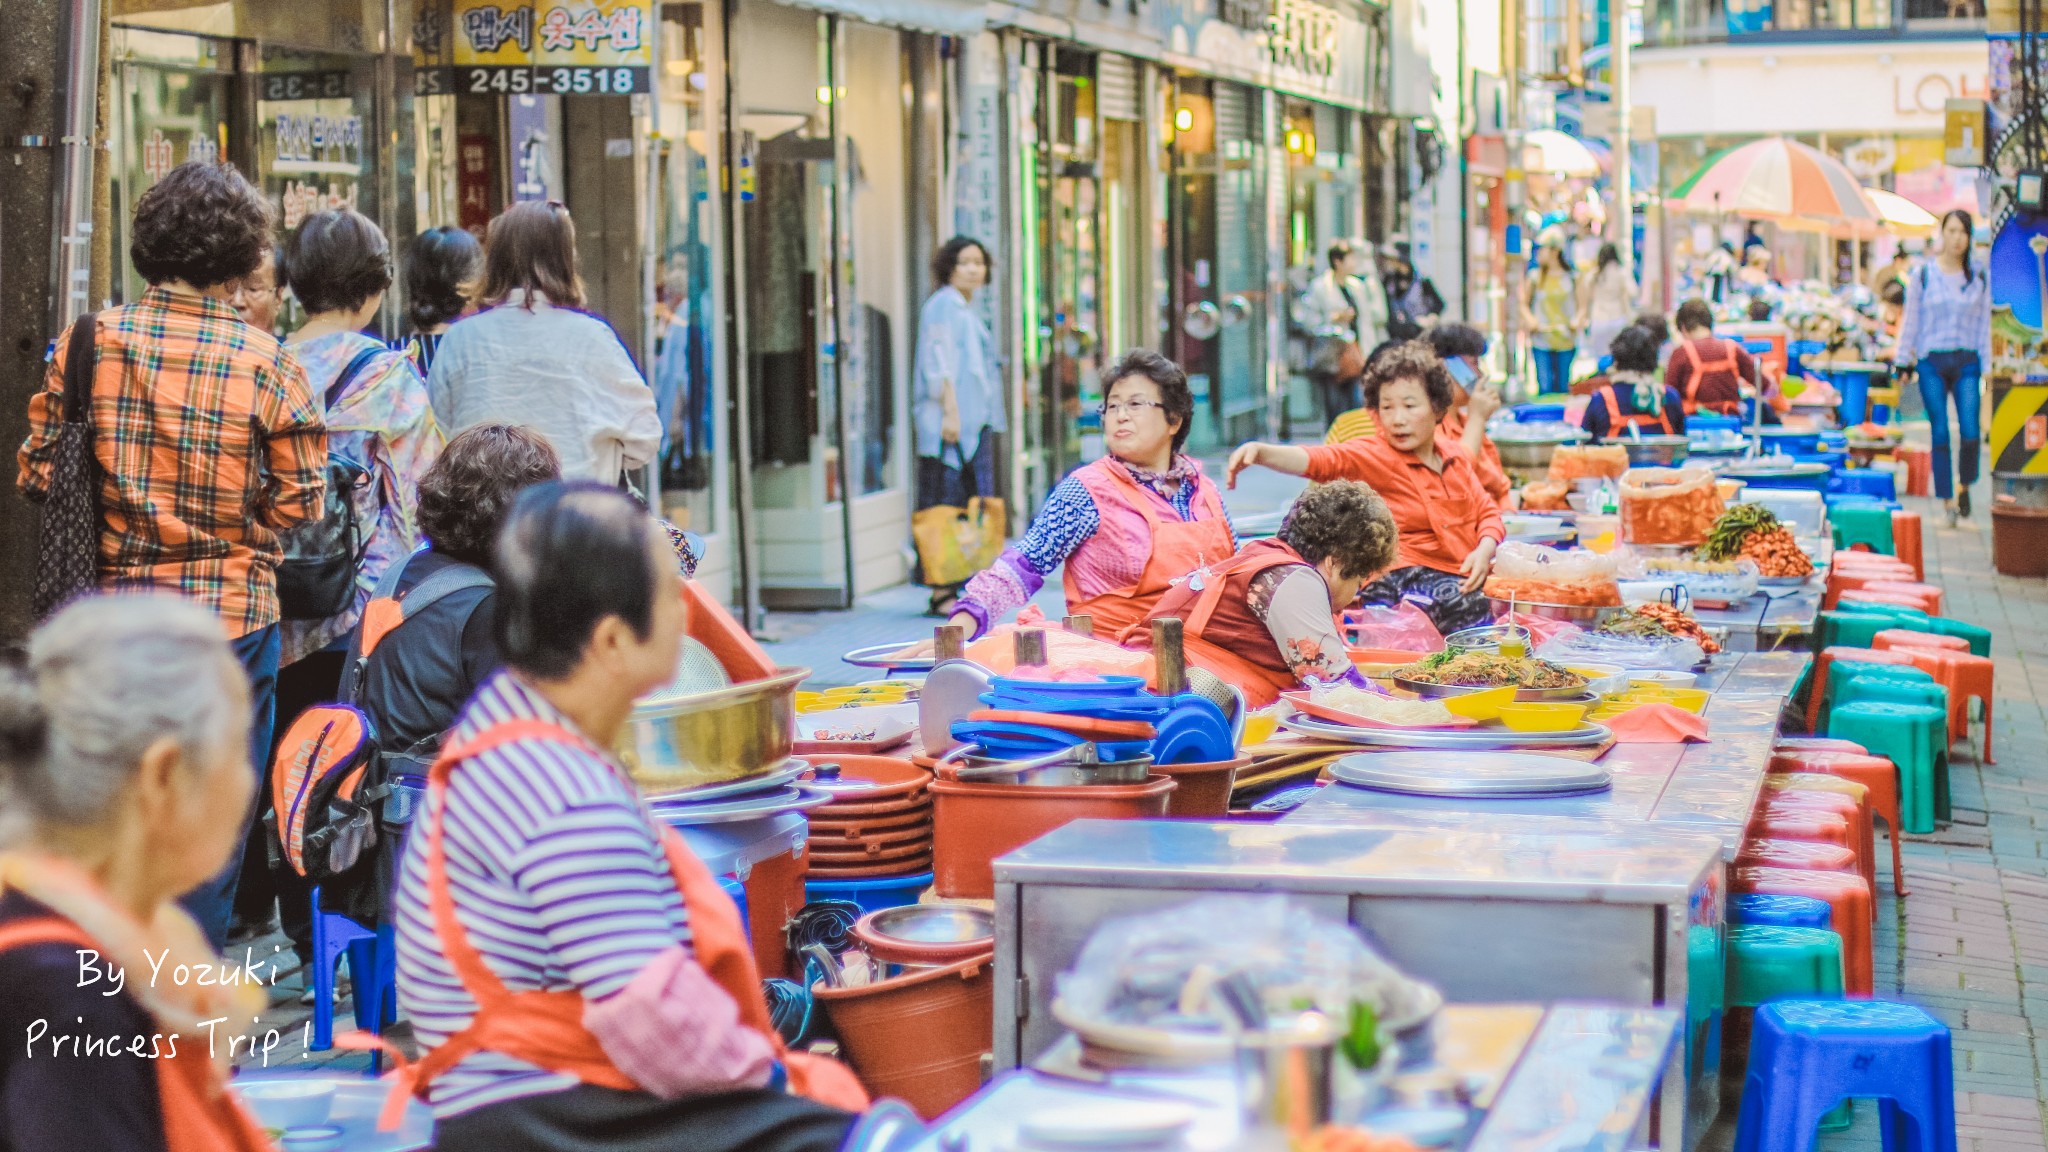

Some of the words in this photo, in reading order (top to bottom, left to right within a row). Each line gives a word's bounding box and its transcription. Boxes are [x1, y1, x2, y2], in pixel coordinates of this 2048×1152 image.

[463, 6, 530, 51] 맵시
[540, 7, 641, 51] 옷수선
[470, 68, 634, 94] 245-3518
